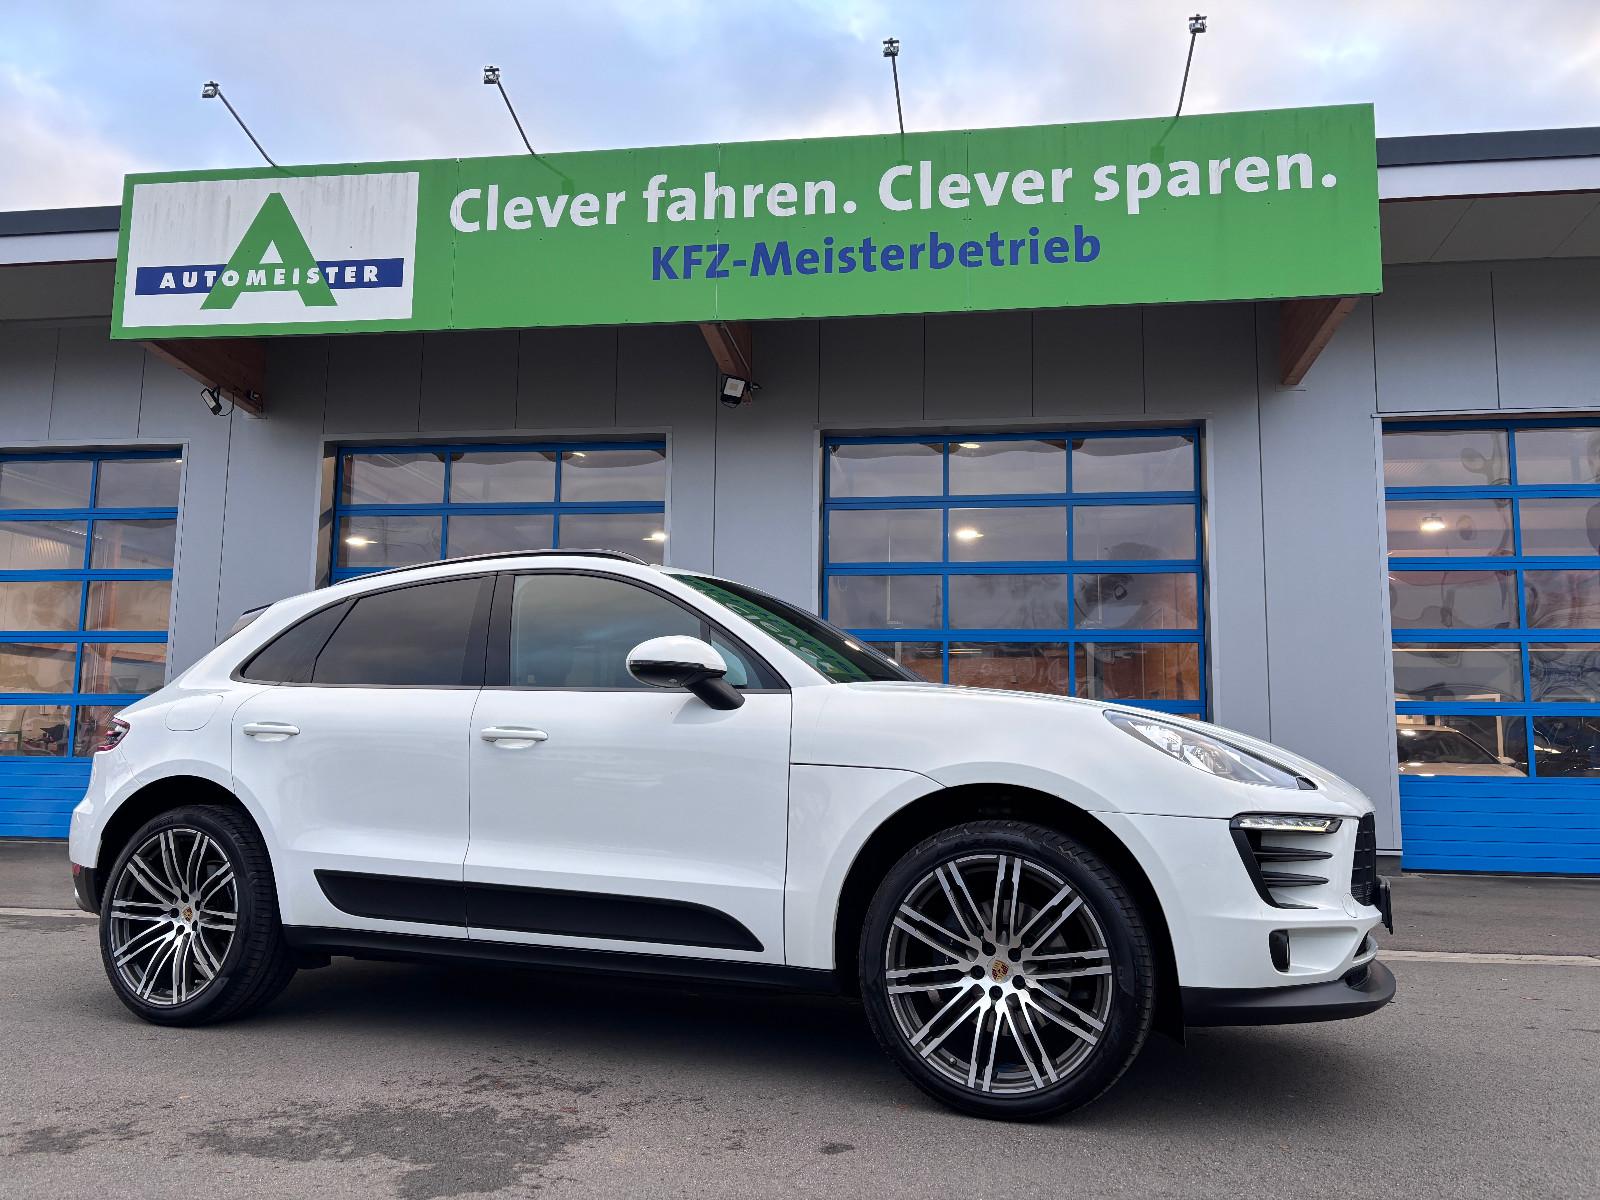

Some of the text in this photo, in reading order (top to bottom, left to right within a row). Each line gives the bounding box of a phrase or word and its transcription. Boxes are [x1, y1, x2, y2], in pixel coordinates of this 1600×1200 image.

[450, 152, 1337, 233] Clever fahren. Clever sparen.
[159, 265, 379, 289] AUTOMEISTER
[652, 225, 1101, 281] KFZ-Meisterbetrieb
